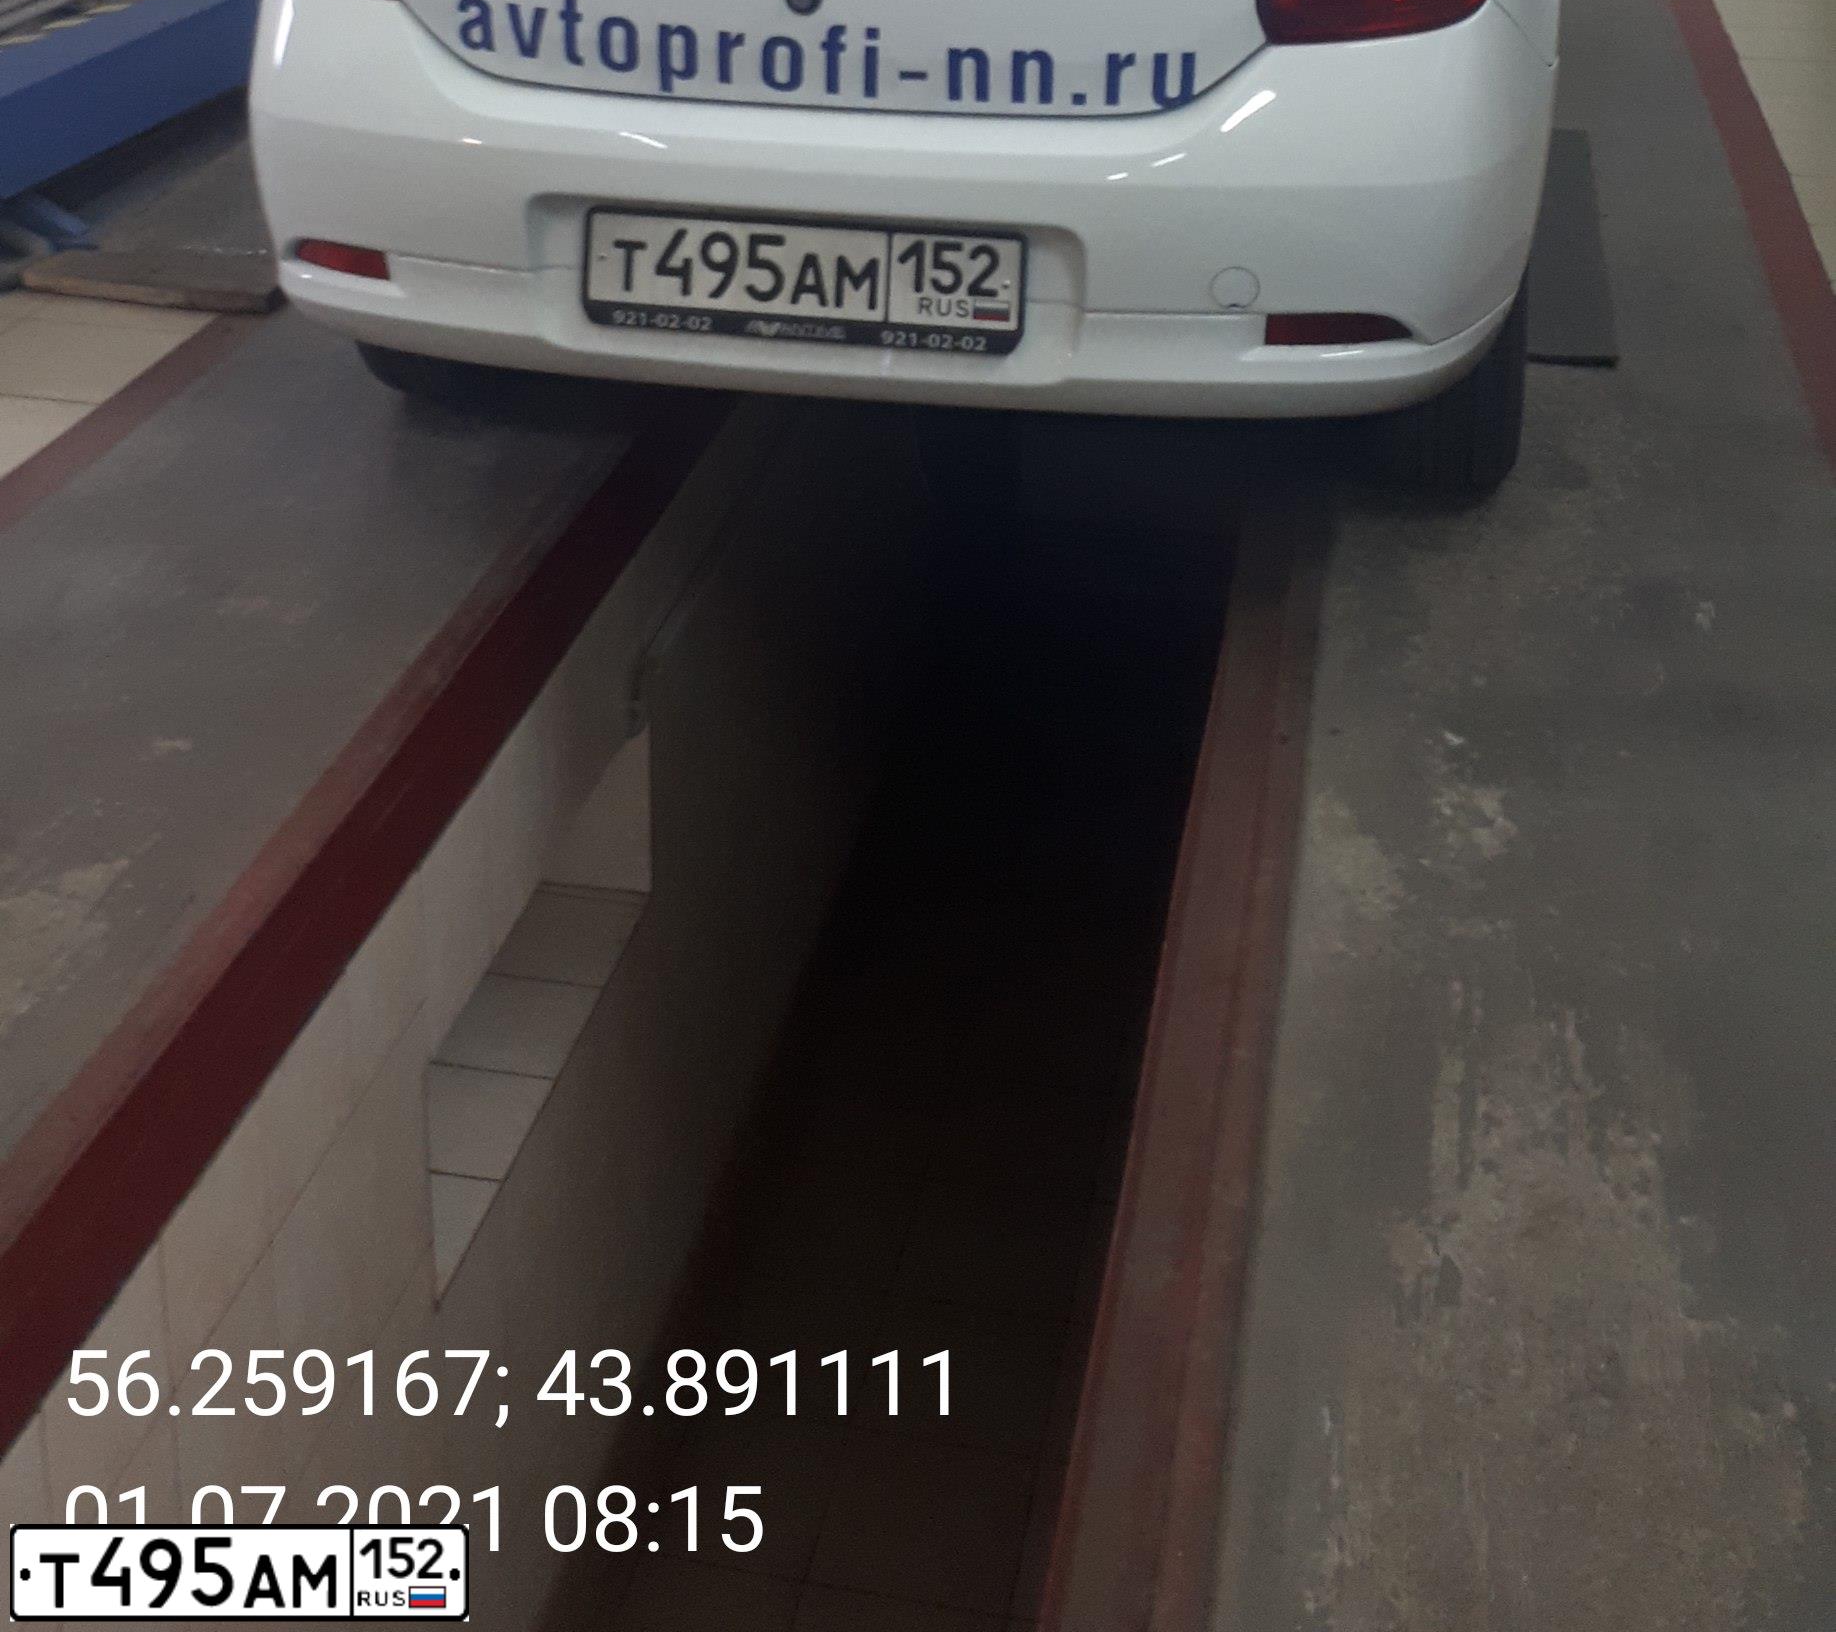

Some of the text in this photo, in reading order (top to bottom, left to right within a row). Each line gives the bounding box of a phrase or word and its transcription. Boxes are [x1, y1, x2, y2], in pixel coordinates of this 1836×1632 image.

[896, 239, 1000, 298] 152
[917, 295, 971, 318] RUS
[880, 329, 988, 352] 921-02-02
